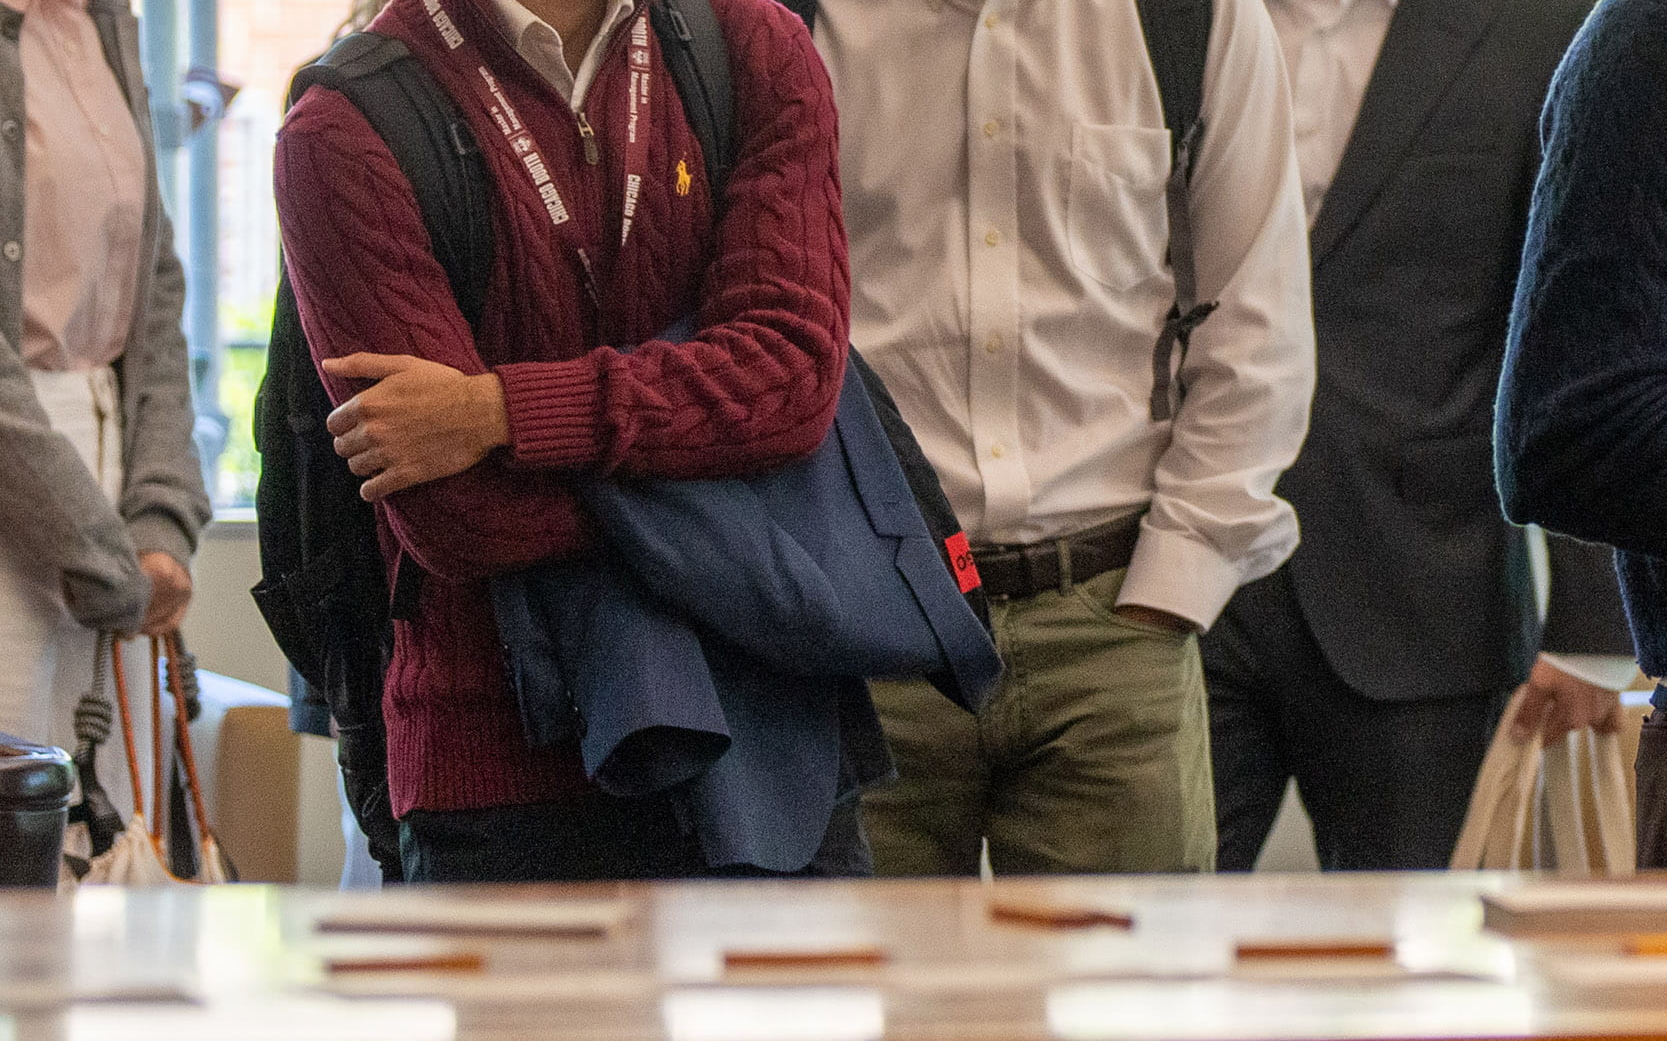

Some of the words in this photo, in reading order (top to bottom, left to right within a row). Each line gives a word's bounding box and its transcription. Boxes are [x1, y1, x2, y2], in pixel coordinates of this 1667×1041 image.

[433, 10, 465, 50] CHICAGO
[641, 73, 650, 96] Master
[628, 113, 638, 143] Program
[523, 152, 551, 186] BOOTH
[538, 182, 570, 225] CHICAGO
[624, 174, 641, 217] CHICAGO
